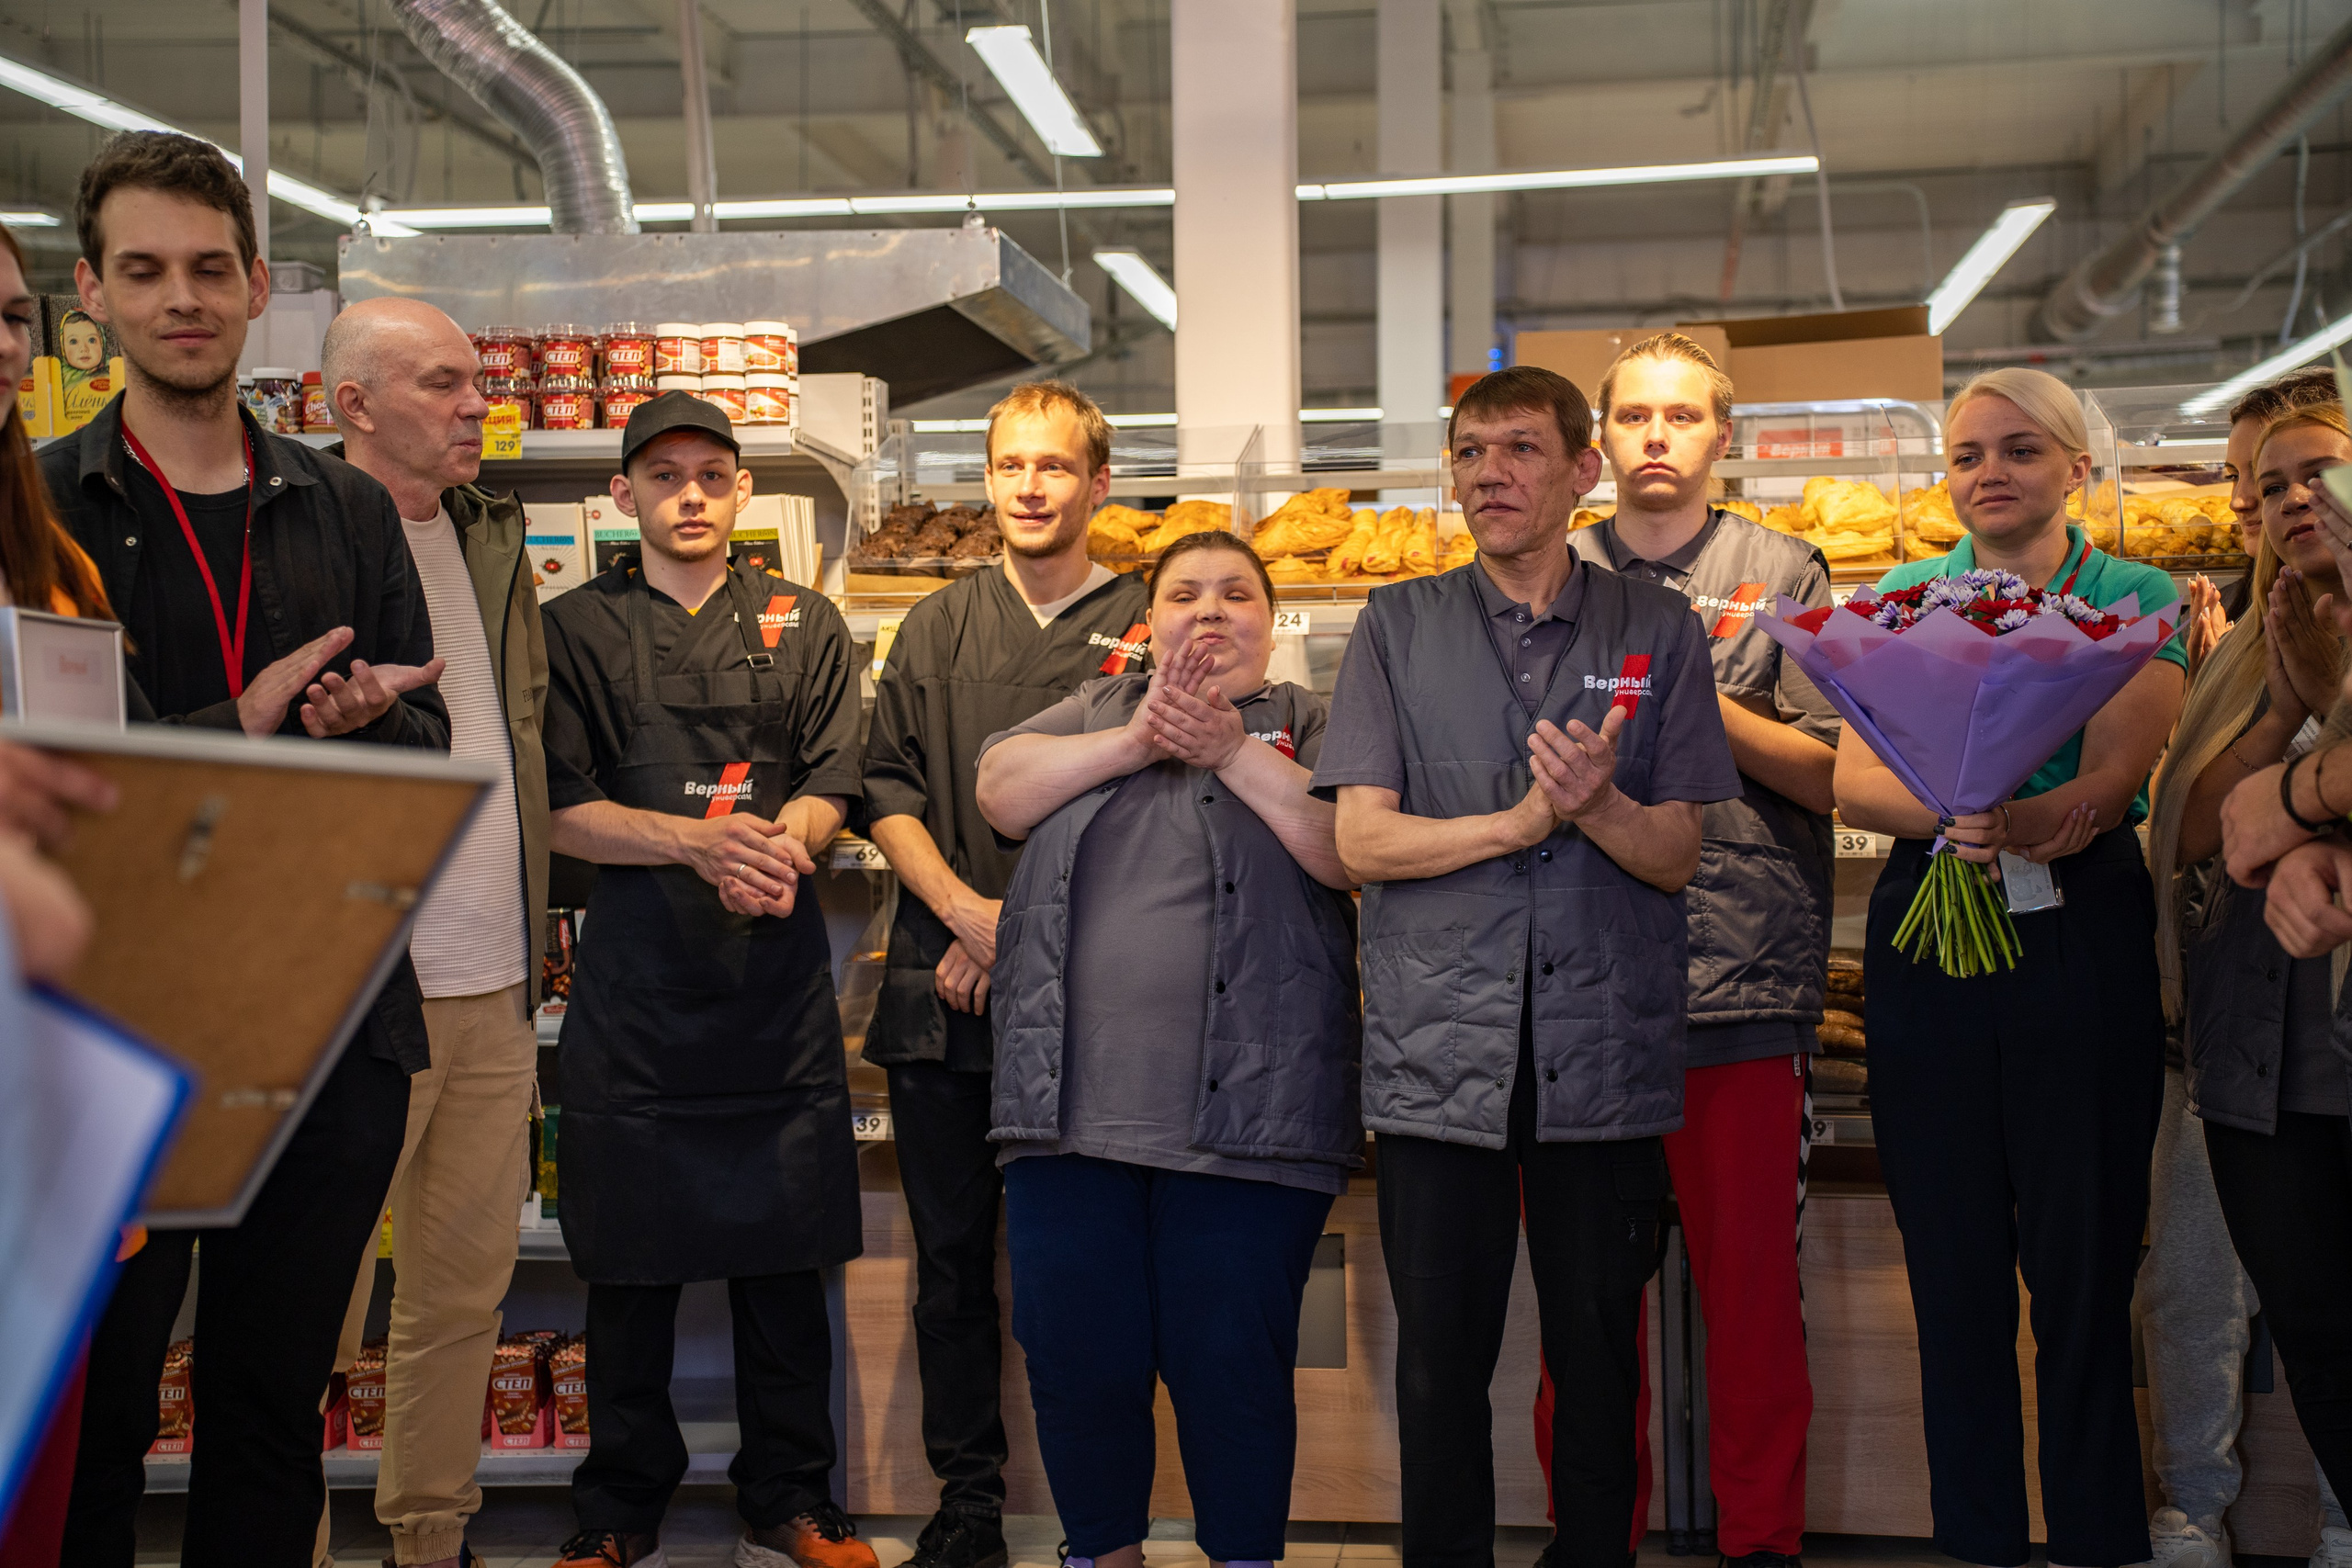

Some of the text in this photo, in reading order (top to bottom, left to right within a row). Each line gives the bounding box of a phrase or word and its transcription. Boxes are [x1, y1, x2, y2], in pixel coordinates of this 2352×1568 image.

[481, 355, 509, 366] СТЕП
[547, 353, 577, 363] СТЕП
[610, 351, 640, 362] СТЕП
[305, 400, 327, 415] Choc
[545, 405, 574, 416] СТЕП
[494, 440, 515, 452] 129
[1696, 595, 1767, 612] Верный
[734, 608, 801, 623] рный
[1278, 613, 1301, 627] 24
[1722, 610, 1755, 619] универс
[1088, 632, 1148, 655] Верный
[1583, 674, 1652, 692] Верный
[1250, 730, 1292, 743] Верн
[684, 778, 753, 798] Верный
[710, 794, 752, 803] универсам
[1842, 835, 1868, 851] 39
[855, 846, 879, 862] 69
[855, 1117, 881, 1133] 39
[1813, 1121, 1826, 1137] 9
[494, 1378, 530, 1391] СТЕП
[158, 1387, 183, 1400] ТЕП
